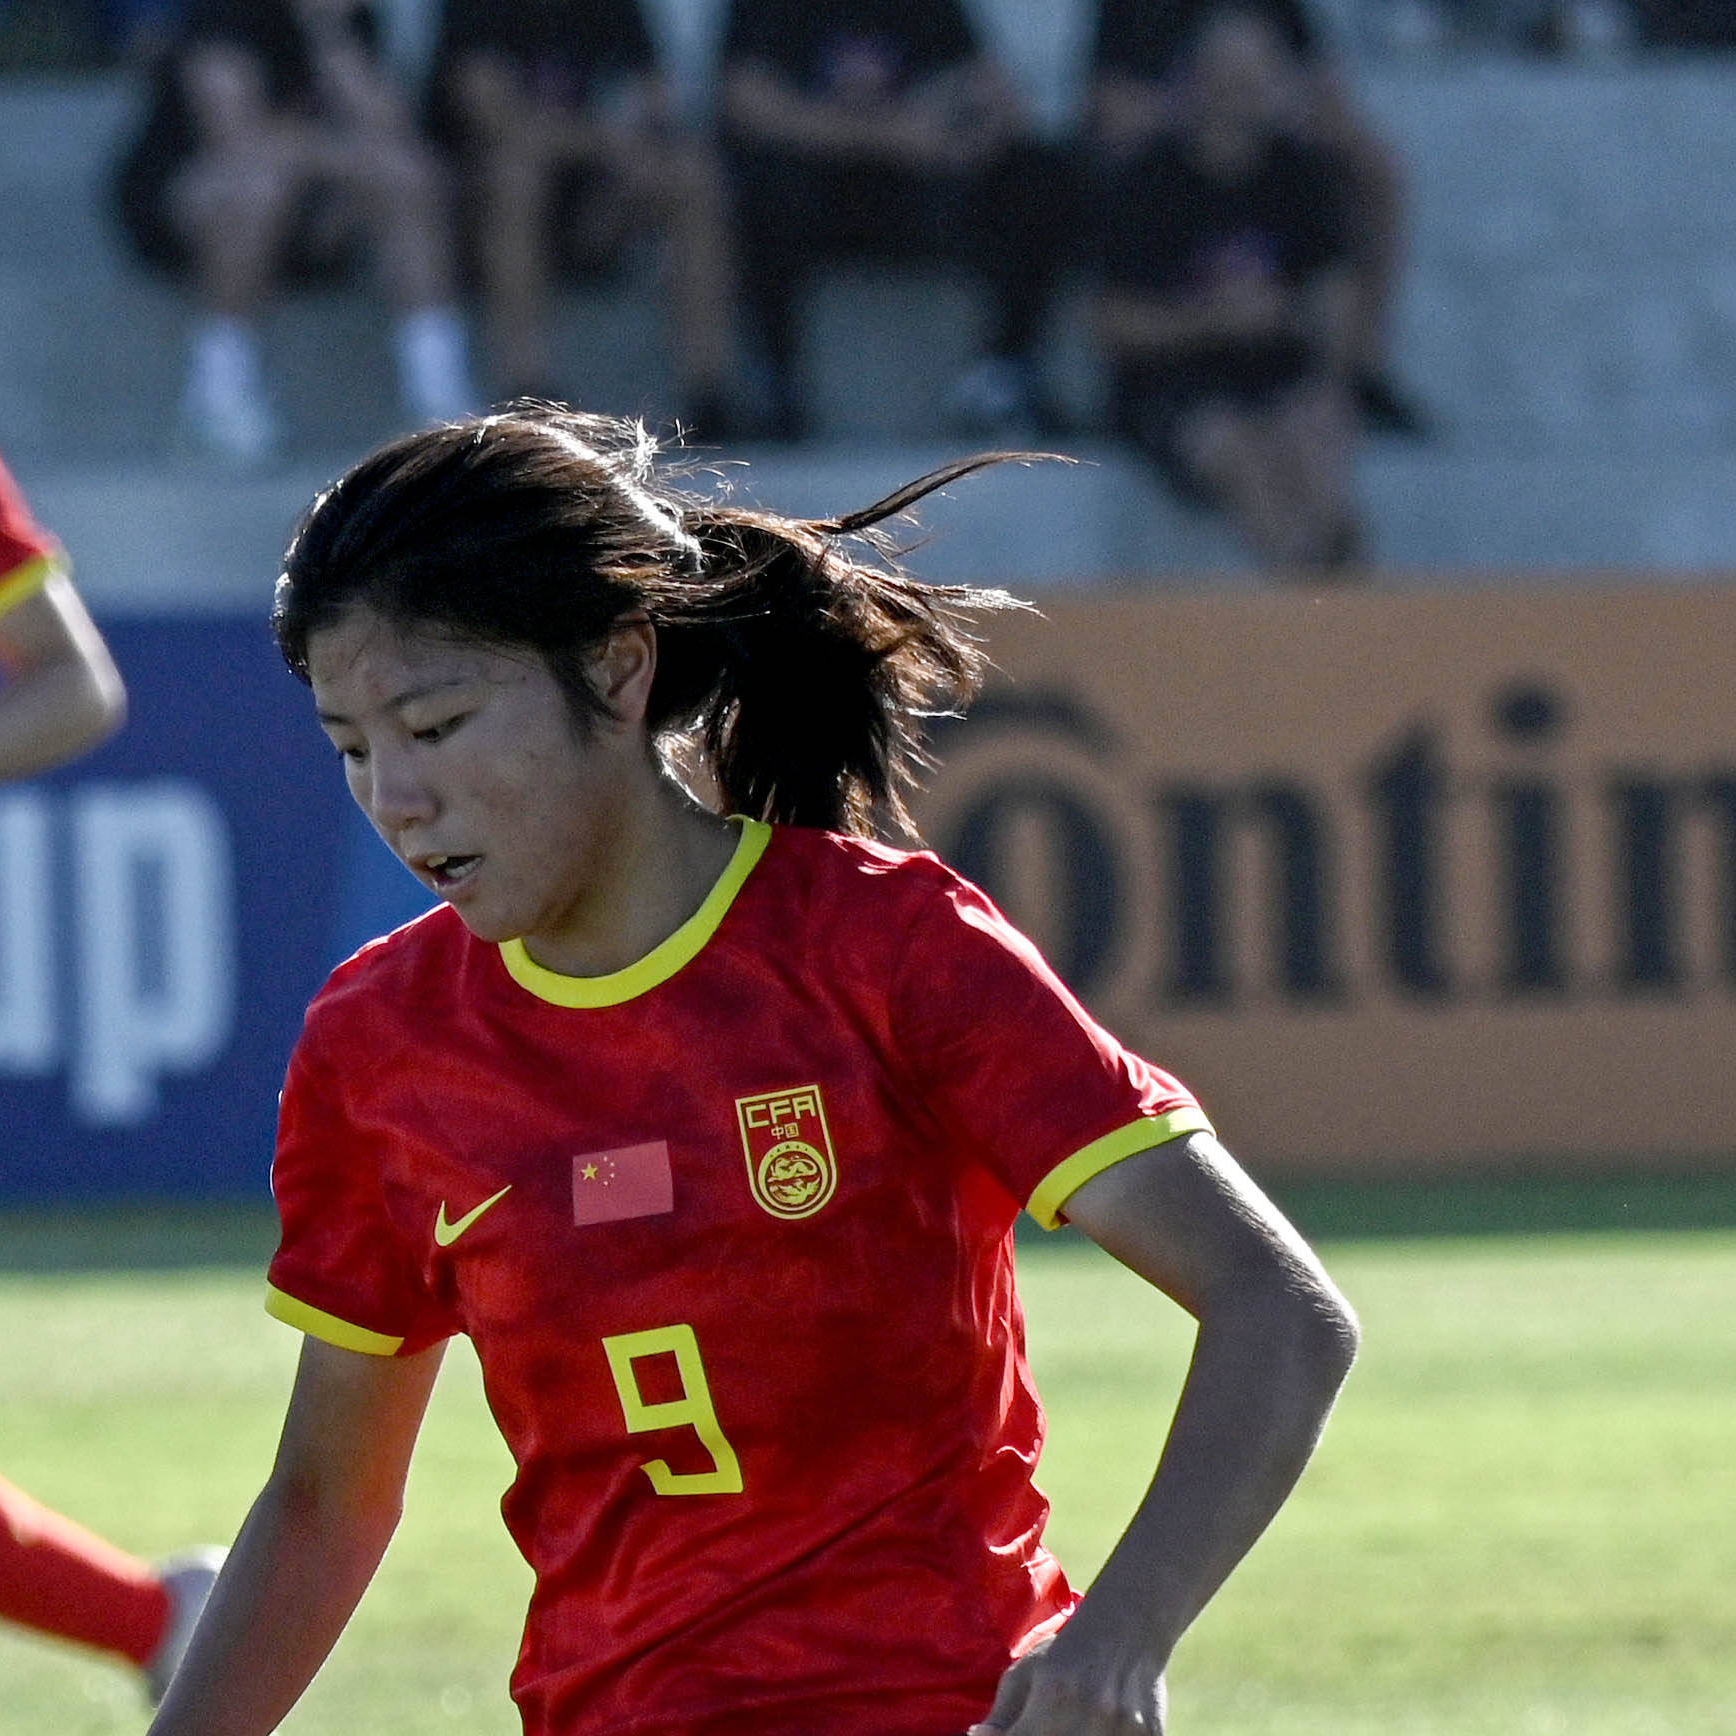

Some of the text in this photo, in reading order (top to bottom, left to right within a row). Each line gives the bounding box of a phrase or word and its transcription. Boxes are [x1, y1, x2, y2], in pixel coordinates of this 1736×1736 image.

[924, 678, 1736, 1012] ontin
[746, 1095, 817, 1129] CFA
[602, 1323, 745, 1496] 9
